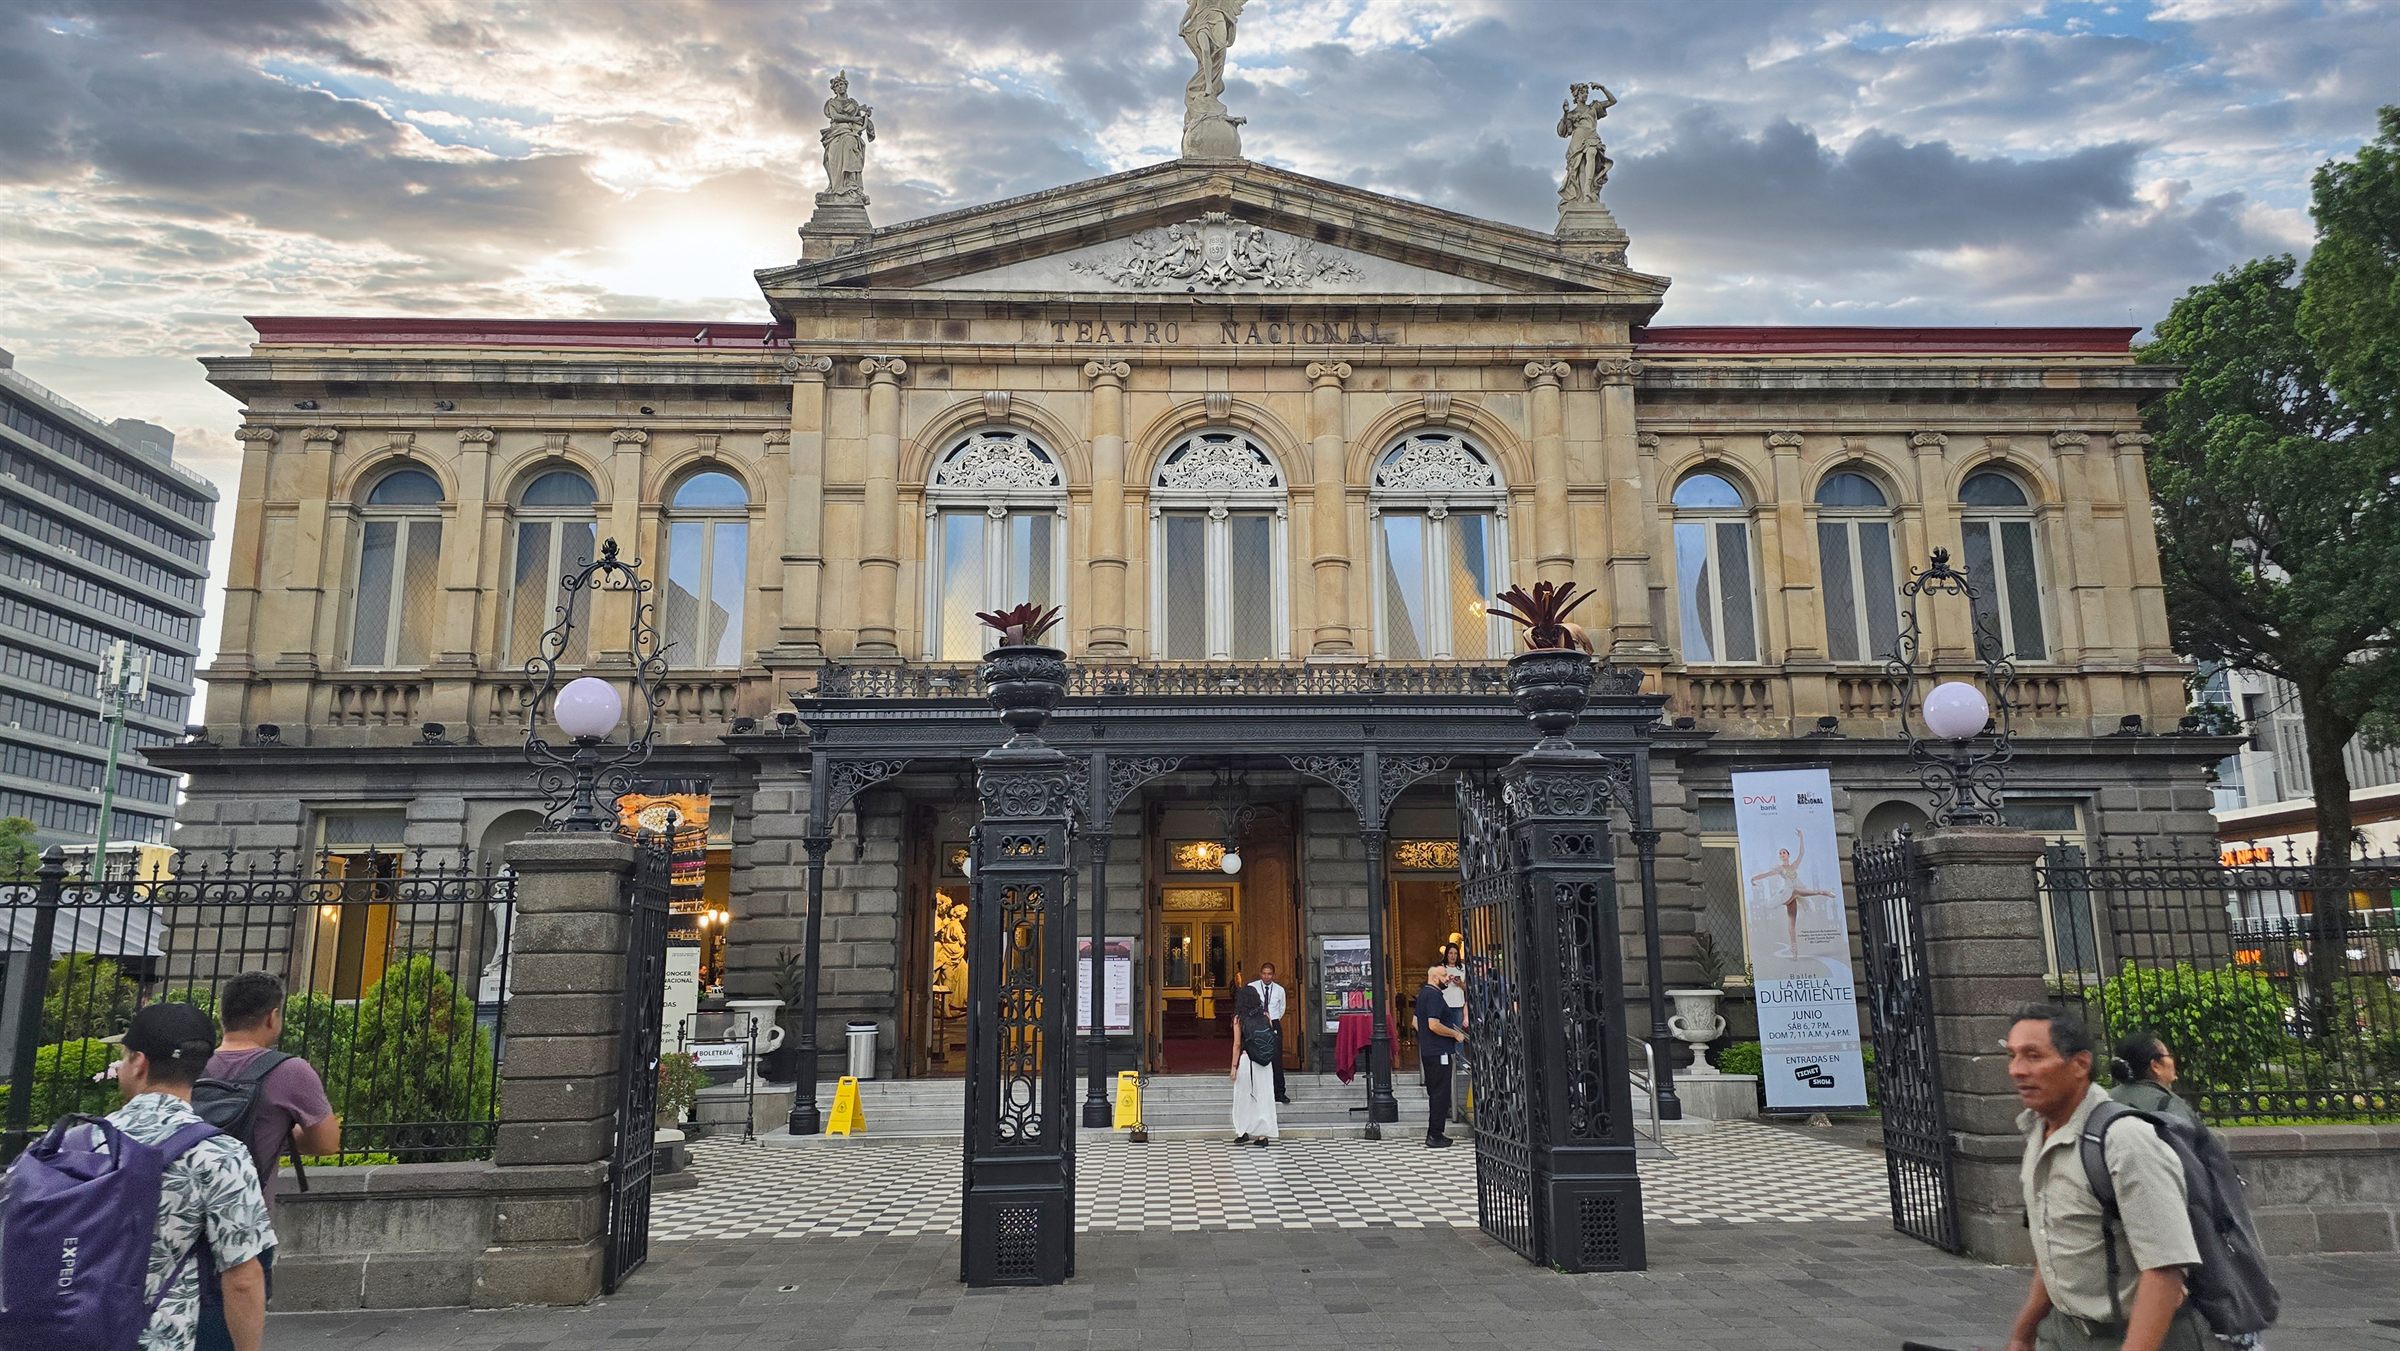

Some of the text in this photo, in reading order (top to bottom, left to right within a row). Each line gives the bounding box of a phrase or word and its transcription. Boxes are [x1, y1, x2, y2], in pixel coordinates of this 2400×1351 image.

[1050, 320, 1388, 345] TEATRO NACIONAL
[1743, 795, 1776, 805] DAVI
[1779, 979, 1831, 990] LA BELLA
[1760, 987, 1853, 1004] DURMIENTE
[1791, 1009, 1823, 1021] JUNIO
[1825, 1031, 1830, 1039] y
[699, 1049, 734, 1057] BOLETERÍA
[1786, 1055, 1828, 1064] ENTRADAS
[1795, 1067, 1819, 1078] TICKET
[57, 1237, 79, 1288] EXPED
